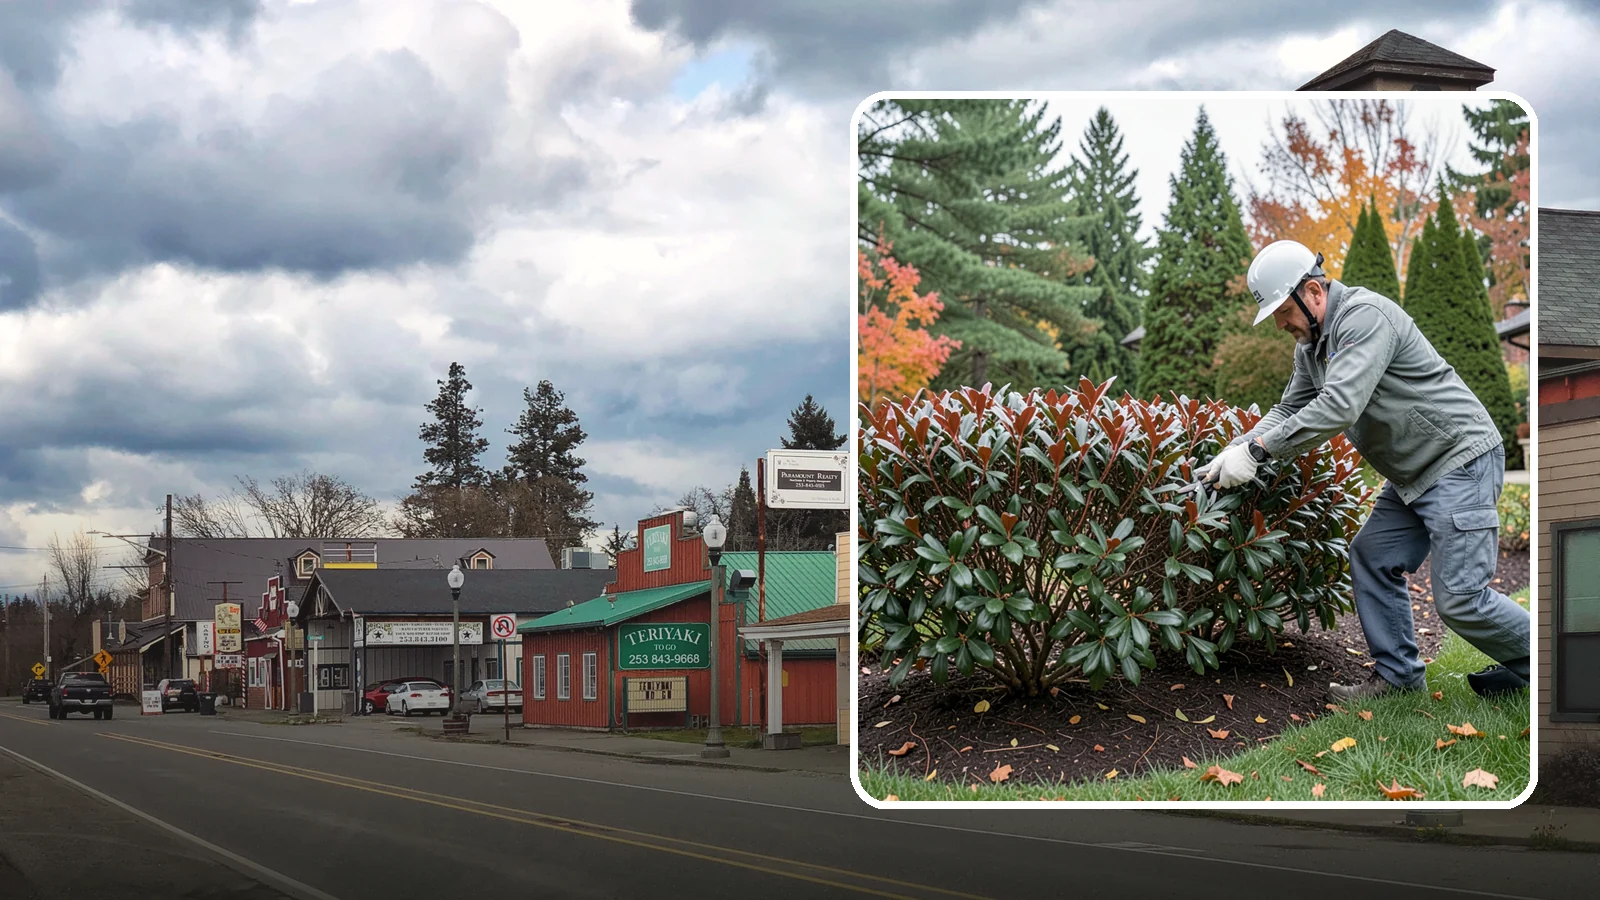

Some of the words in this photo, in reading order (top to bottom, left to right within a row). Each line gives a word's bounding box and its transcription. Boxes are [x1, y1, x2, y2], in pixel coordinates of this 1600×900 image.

[625, 628, 702, 646] TERIYAKI
[629, 654, 648, 664] 253
[652, 654, 700, 664] 843-9668
